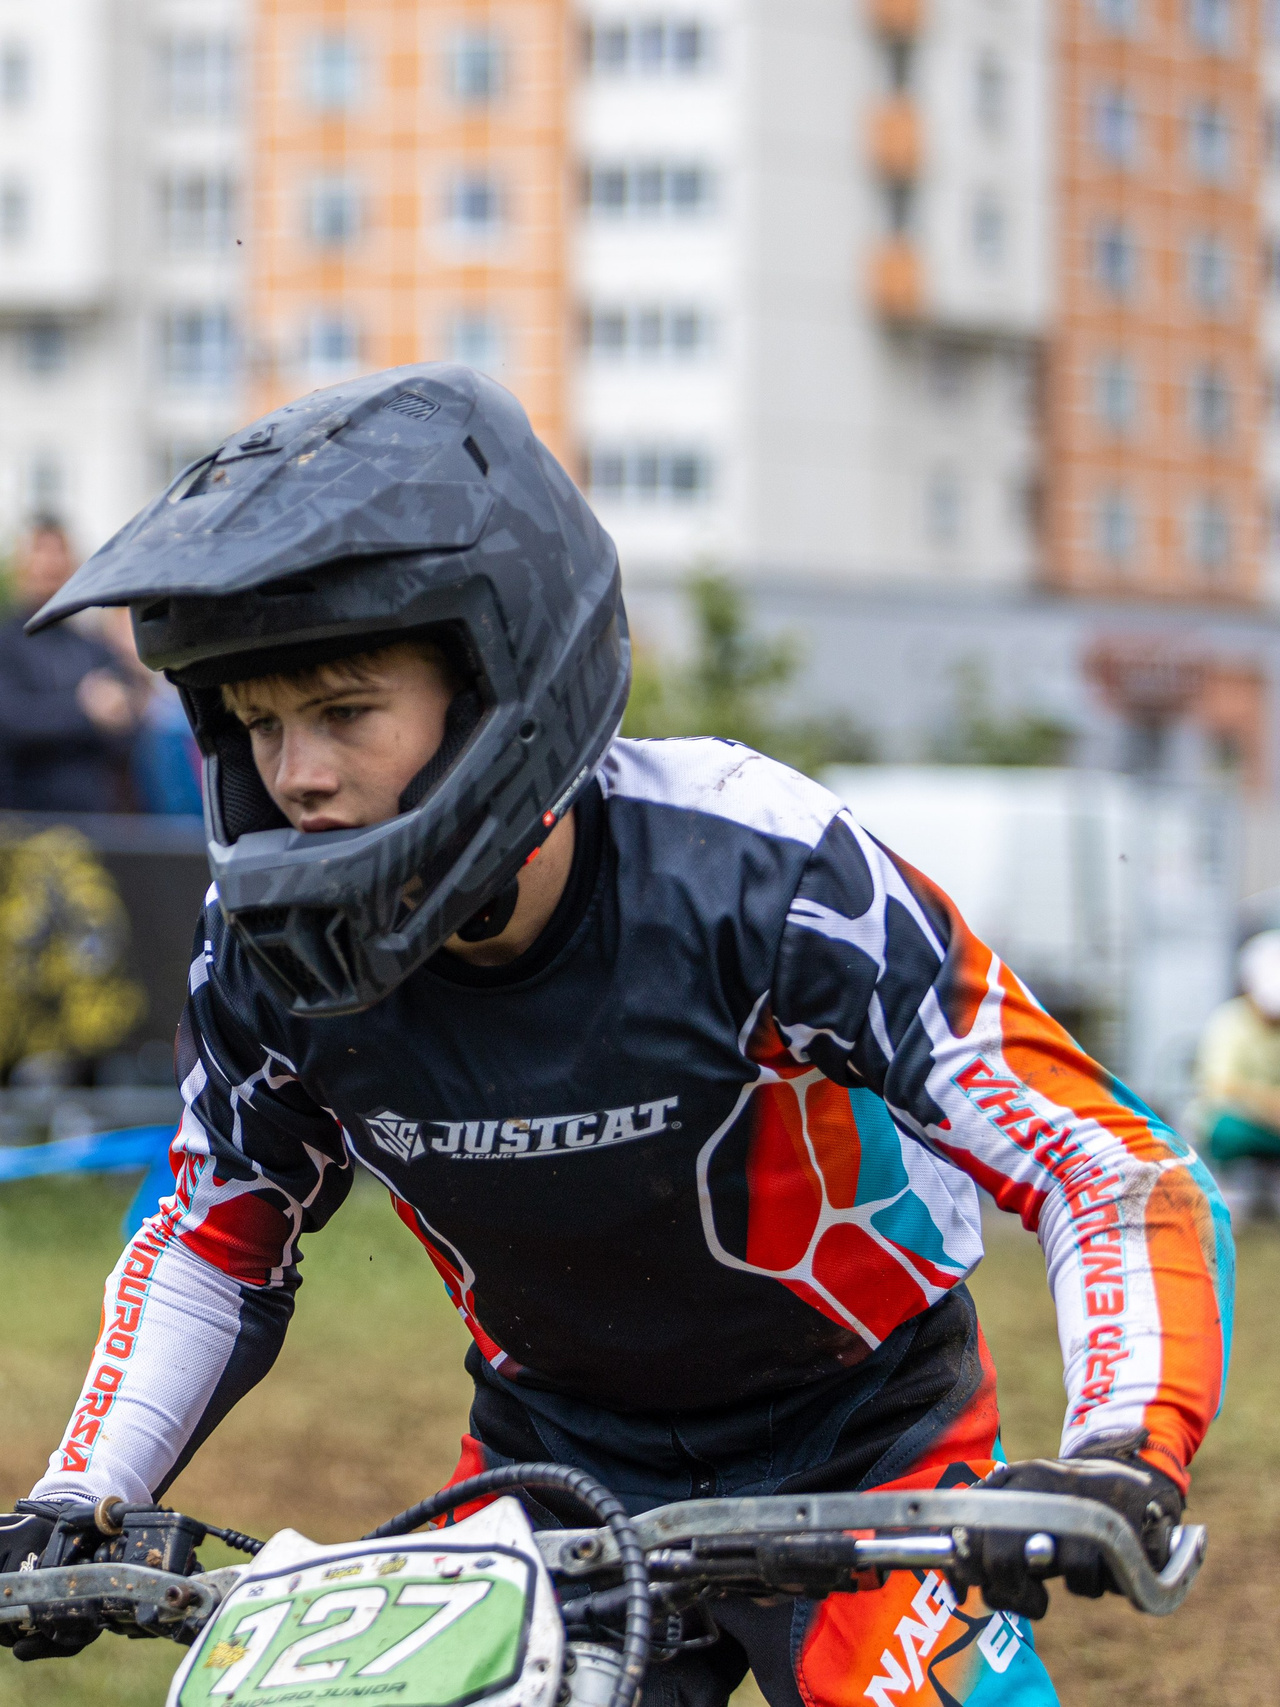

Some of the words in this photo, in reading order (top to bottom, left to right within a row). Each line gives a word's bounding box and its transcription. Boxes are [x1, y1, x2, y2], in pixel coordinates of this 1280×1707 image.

[429, 1095, 679, 1153] JUSTCAT
[208, 1579, 495, 1697] 127
[316, 1681, 408, 1698] JUNIOR
